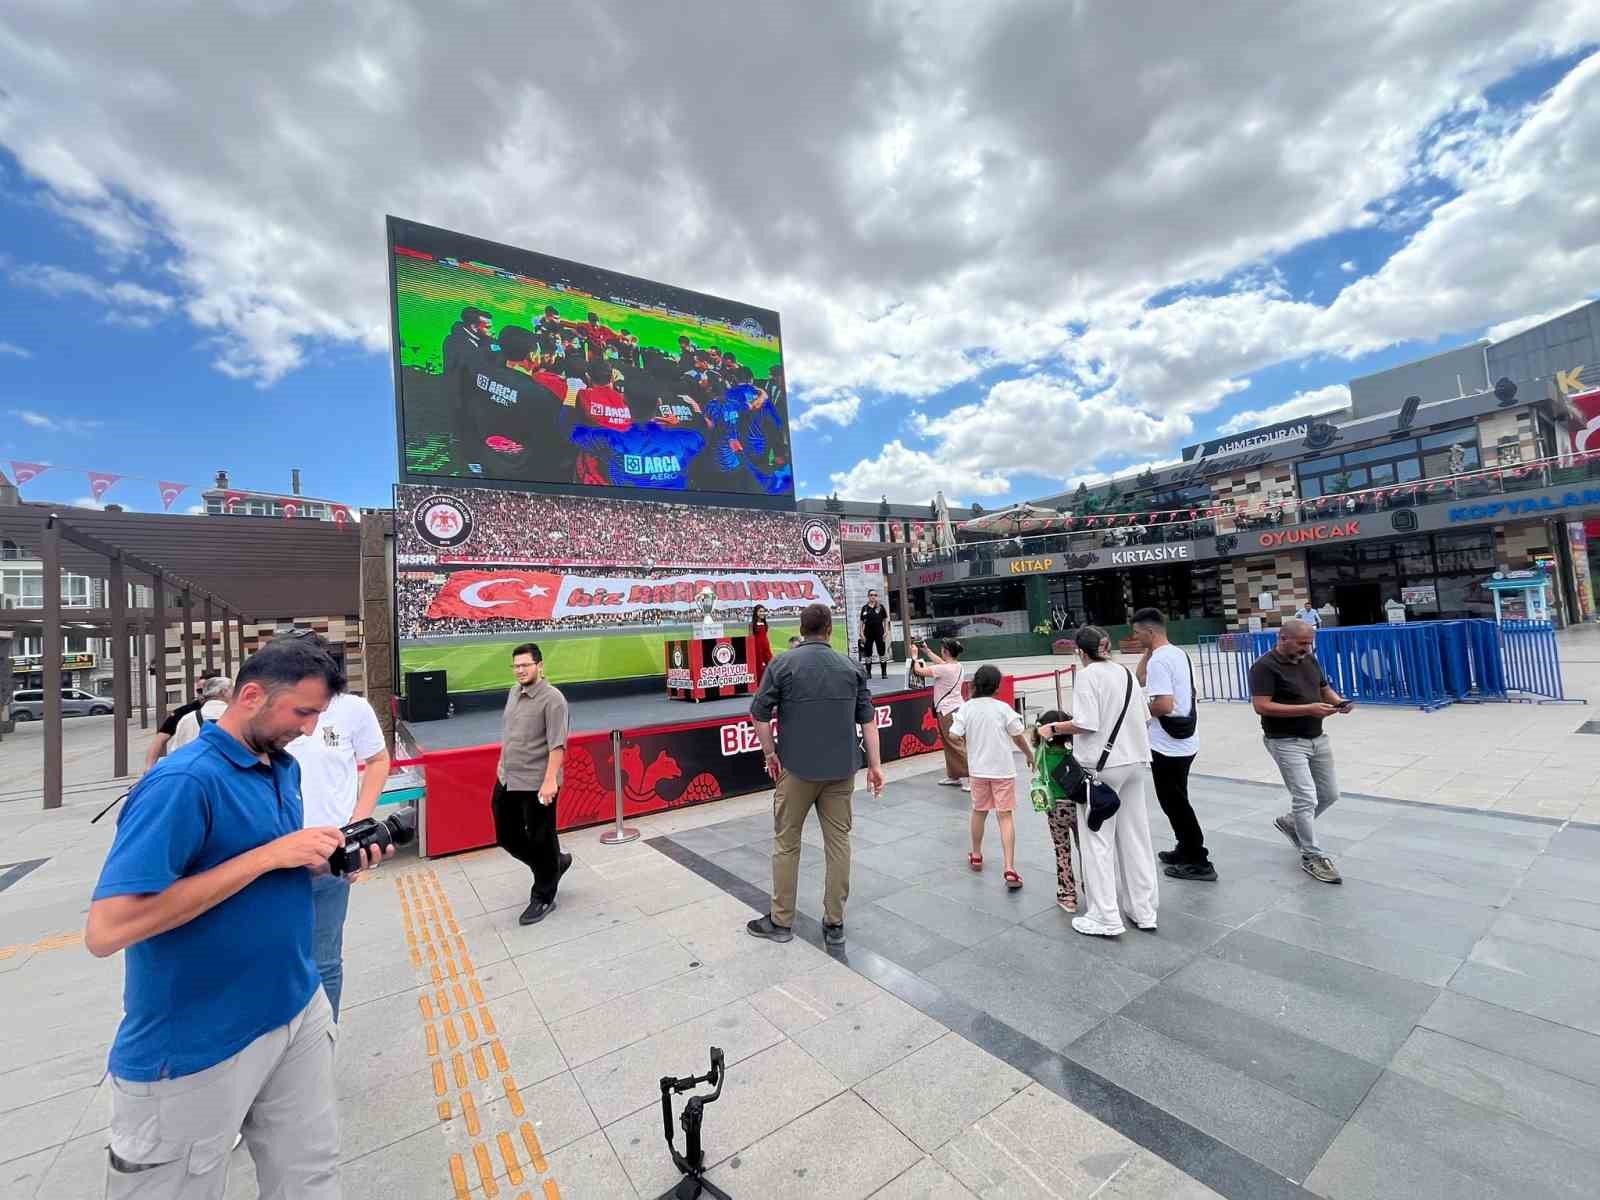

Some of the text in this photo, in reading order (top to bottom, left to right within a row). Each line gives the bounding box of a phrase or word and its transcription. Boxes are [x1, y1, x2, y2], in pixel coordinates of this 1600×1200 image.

[644, 455, 681, 474] ARCA
[1259, 520, 1360, 547] OYUNCAK
[1111, 543, 1189, 565] KIRTASİYE
